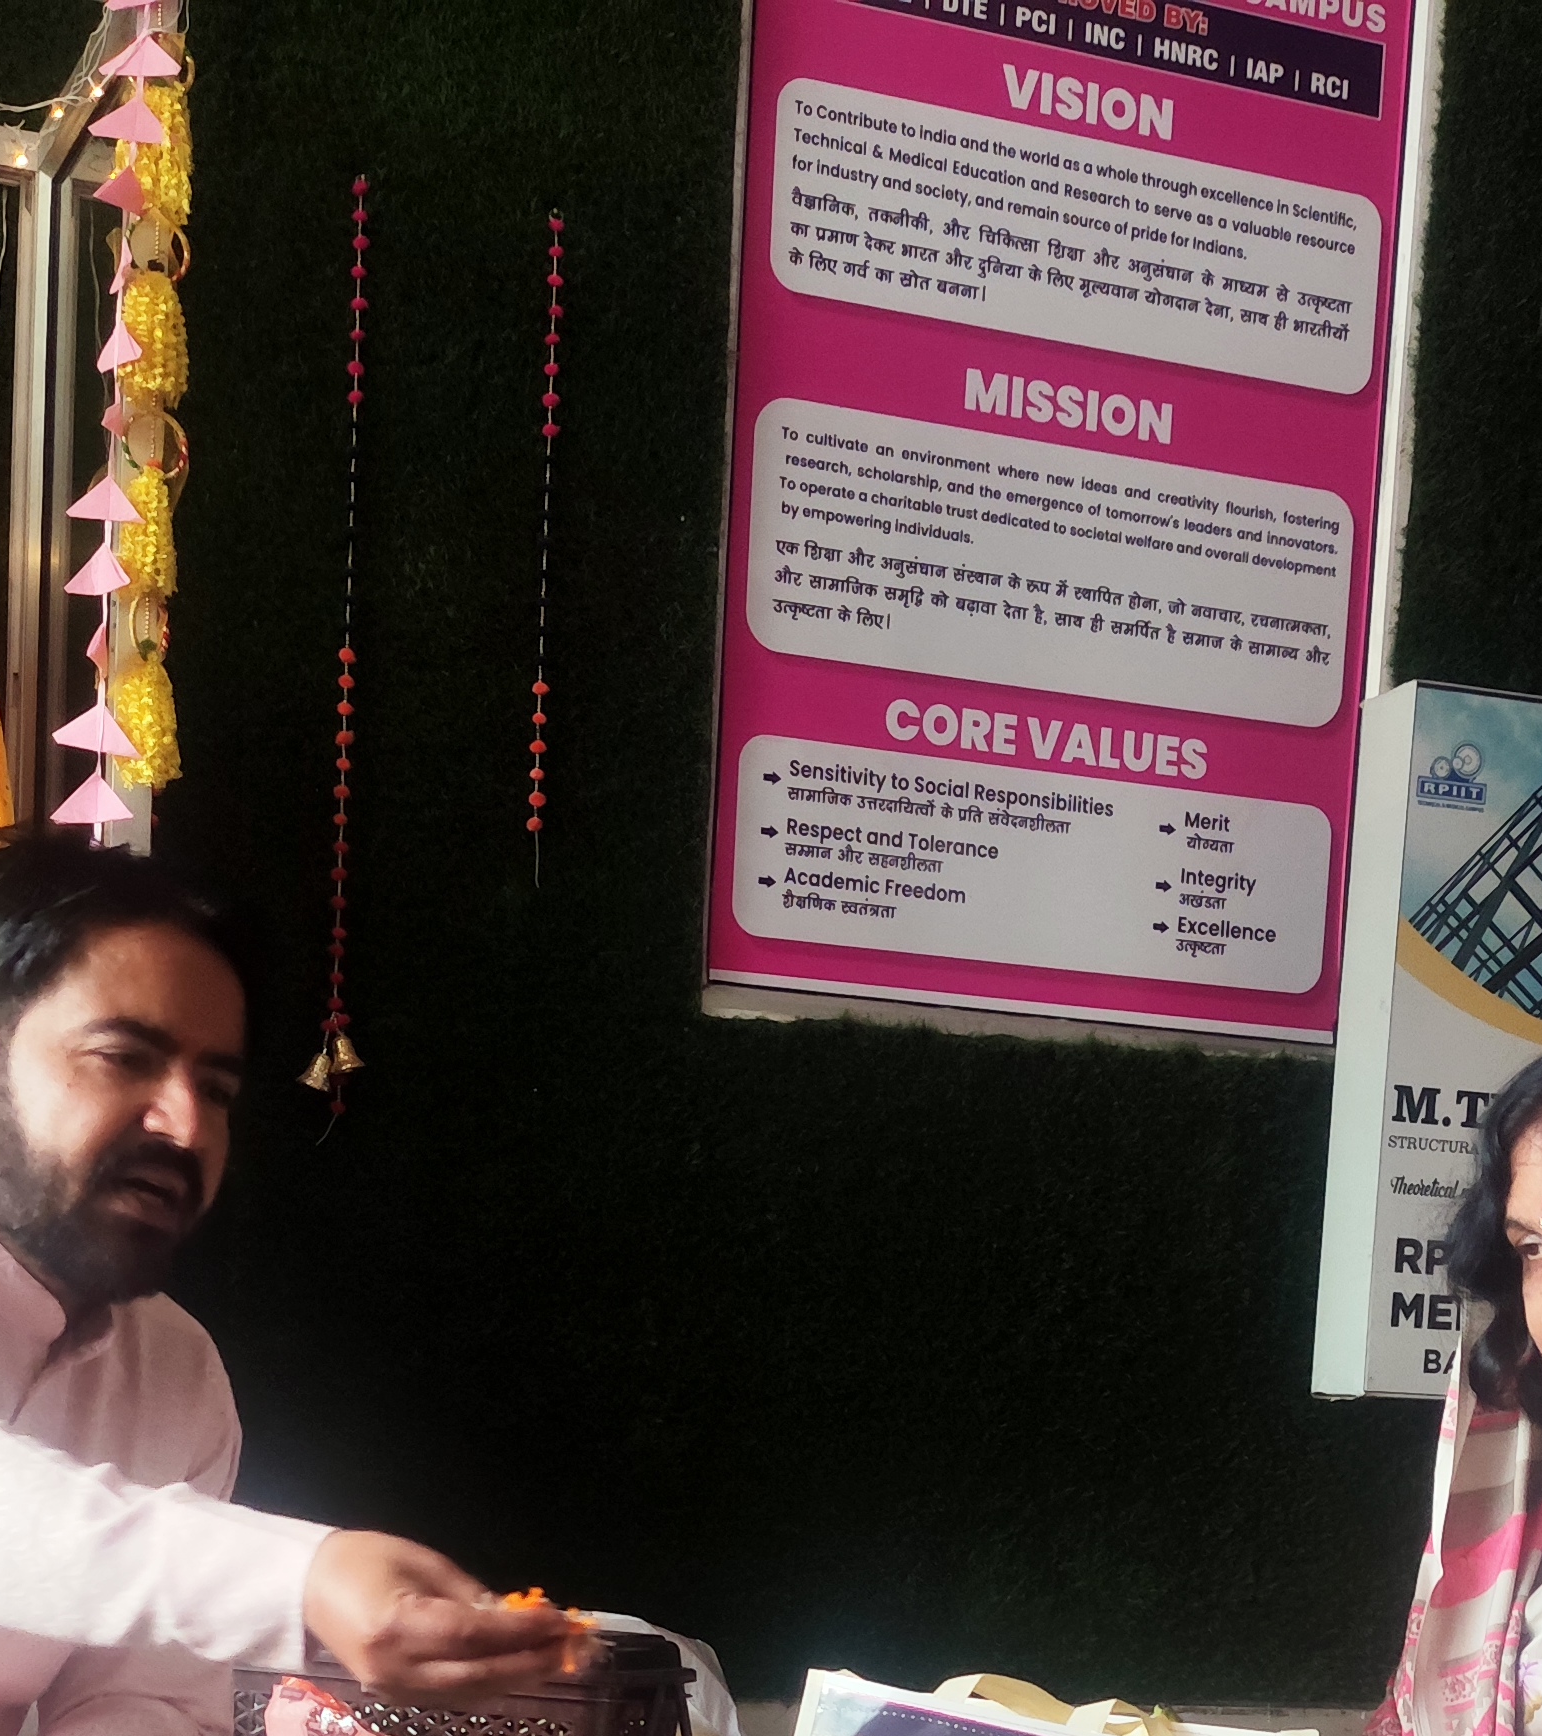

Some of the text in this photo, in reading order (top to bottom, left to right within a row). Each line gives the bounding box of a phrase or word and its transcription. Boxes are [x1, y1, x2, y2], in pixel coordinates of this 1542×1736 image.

[1163, 5, 1209, 35] BY:
[1015, 6, 1056, 35] PCI
[1084, 21, 1126, 50] INC
[1154, 37, 1219, 71] HNRC
[1246, 57, 1284, 85] IAP
[1310, 72, 1350, 100] RCI
[1002, 63, 1174, 140] VISION
[795, 100, 813, 116] To
[816, 105, 898, 134] Contribute
[901, 122, 916, 138] to
[960, 137, 989, 153] and
[992, 141, 1016, 159] the
[1019, 149, 1060, 168] world
[1063, 158, 1080, 172] as
[1083, 163, 1093, 175] a
[1096, 164, 1138, 184] whole
[1142, 172, 1198, 199] through
[1200, 187, 1274, 212] excellence
[1277, 199, 1289, 215] in
[1293, 204, 1357, 231] Scientific,
[792, 154, 813, 172] for
[882, 176, 912, 192] and
[915, 183, 971, 208] society,
[975, 195, 1004, 211] and
[1007, 202, 1059, 222] remain
[1063, 212, 1111, 232] source
[1114, 221, 1128, 235] of
[1131, 225, 1168, 244] pride
[1171, 231, 1190, 248] for
[1193, 236, 1247, 260] Indians.
[794, 127, 1355, 255] Technical & Medical Education and Research to serve as a valuable resource
[964, 367, 1174, 445] MISSION
[782, 426, 1340, 535] To cultivate an environment where new ideas and creativity flourish, fostering
[781, 501, 799, 520] by
[802, 507, 892, 535] empowering
[785, 454, 852, 477] research,
[857, 466, 942, 493] scholarship,
[947, 482, 974, 495] and
[979, 485, 1002, 500] the
[1006, 492, 1084, 513] emergence
[1088, 503, 1101, 516] of
[1184, 518, 1232, 538] leaders
[1237, 529, 1262, 542] and
[1267, 531, 1338, 555] innovators.
[779, 476, 1336, 577] To operate a charitable trust dedicated to societal welfare and overall development
[885, 699, 1208, 779] CORE VALUES
[789, 759, 1115, 816] Sensitivity to Social Responsibilities
[1423, 782, 1481, 799] RPIIT
[786, 818, 999, 859] Respect and Tolerance
[1184, 811, 1230, 832] Merit
[1186, 833, 1235, 854] योग्यता
[784, 867, 966, 904] Academic Freedom
[1181, 868, 1257, 897] Integrity
[1177, 916, 1276, 943] Excellence
[1391, 1084, 1499, 1128] M.T
[1387, 1134, 1479, 1155] STRUCTURA
[1390, 1175, 1459, 1199] Theoretical
[1394, 1237, 1453, 1275] RP
[1390, 1292, 1461, 1331] ME
